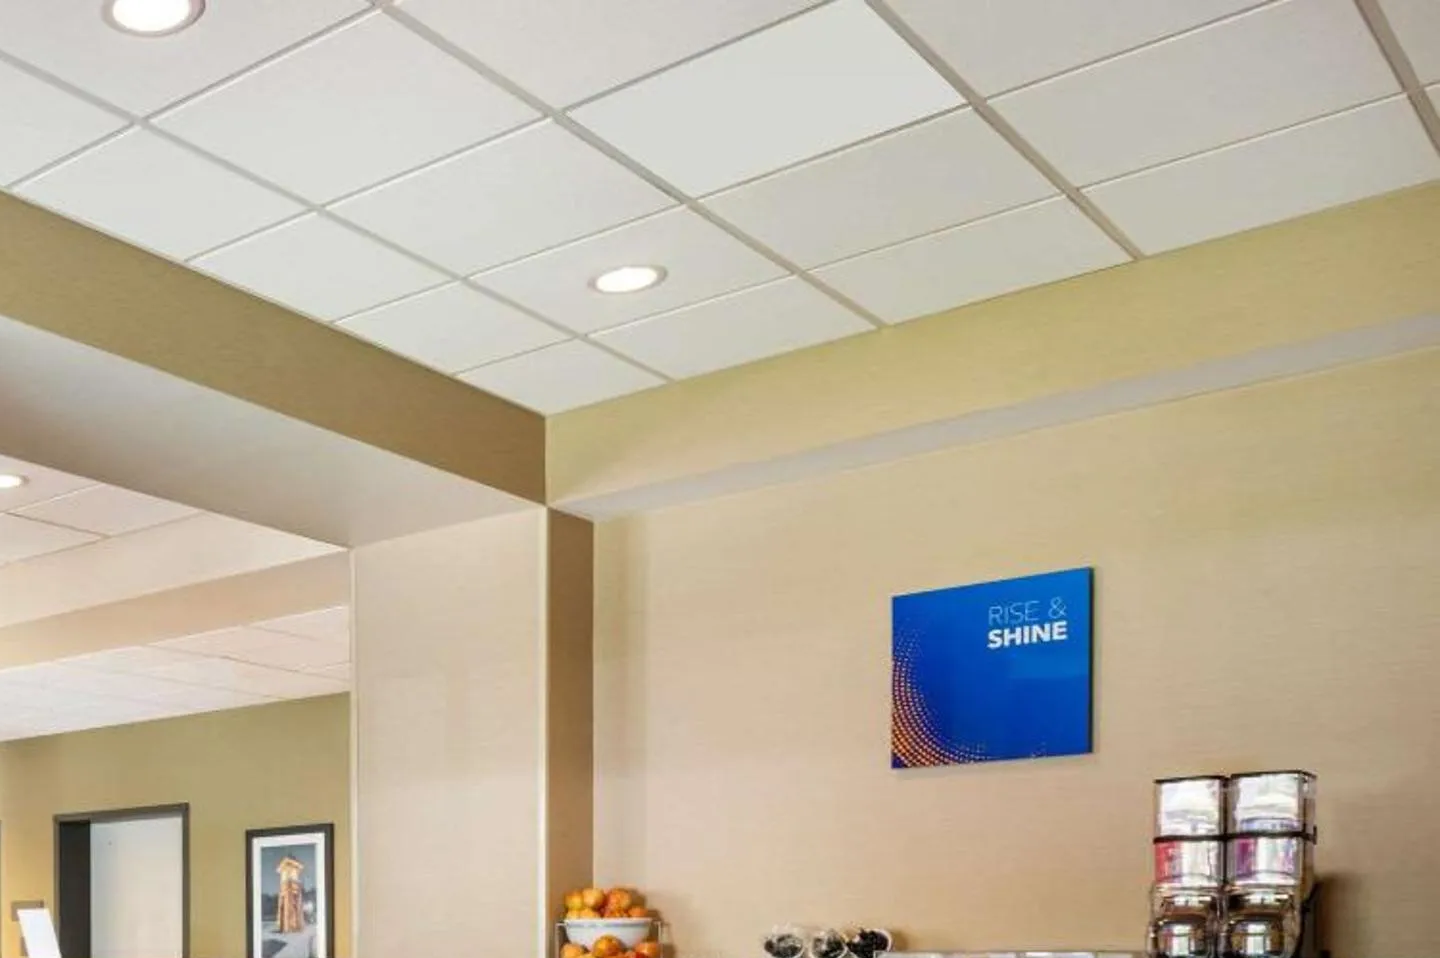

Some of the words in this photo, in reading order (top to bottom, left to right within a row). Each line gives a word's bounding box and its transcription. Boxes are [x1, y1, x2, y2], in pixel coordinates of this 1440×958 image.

[987, 600, 1040, 627] RISE
[1047, 596, 1067, 619] &
[987, 620, 1068, 650] SHINE
